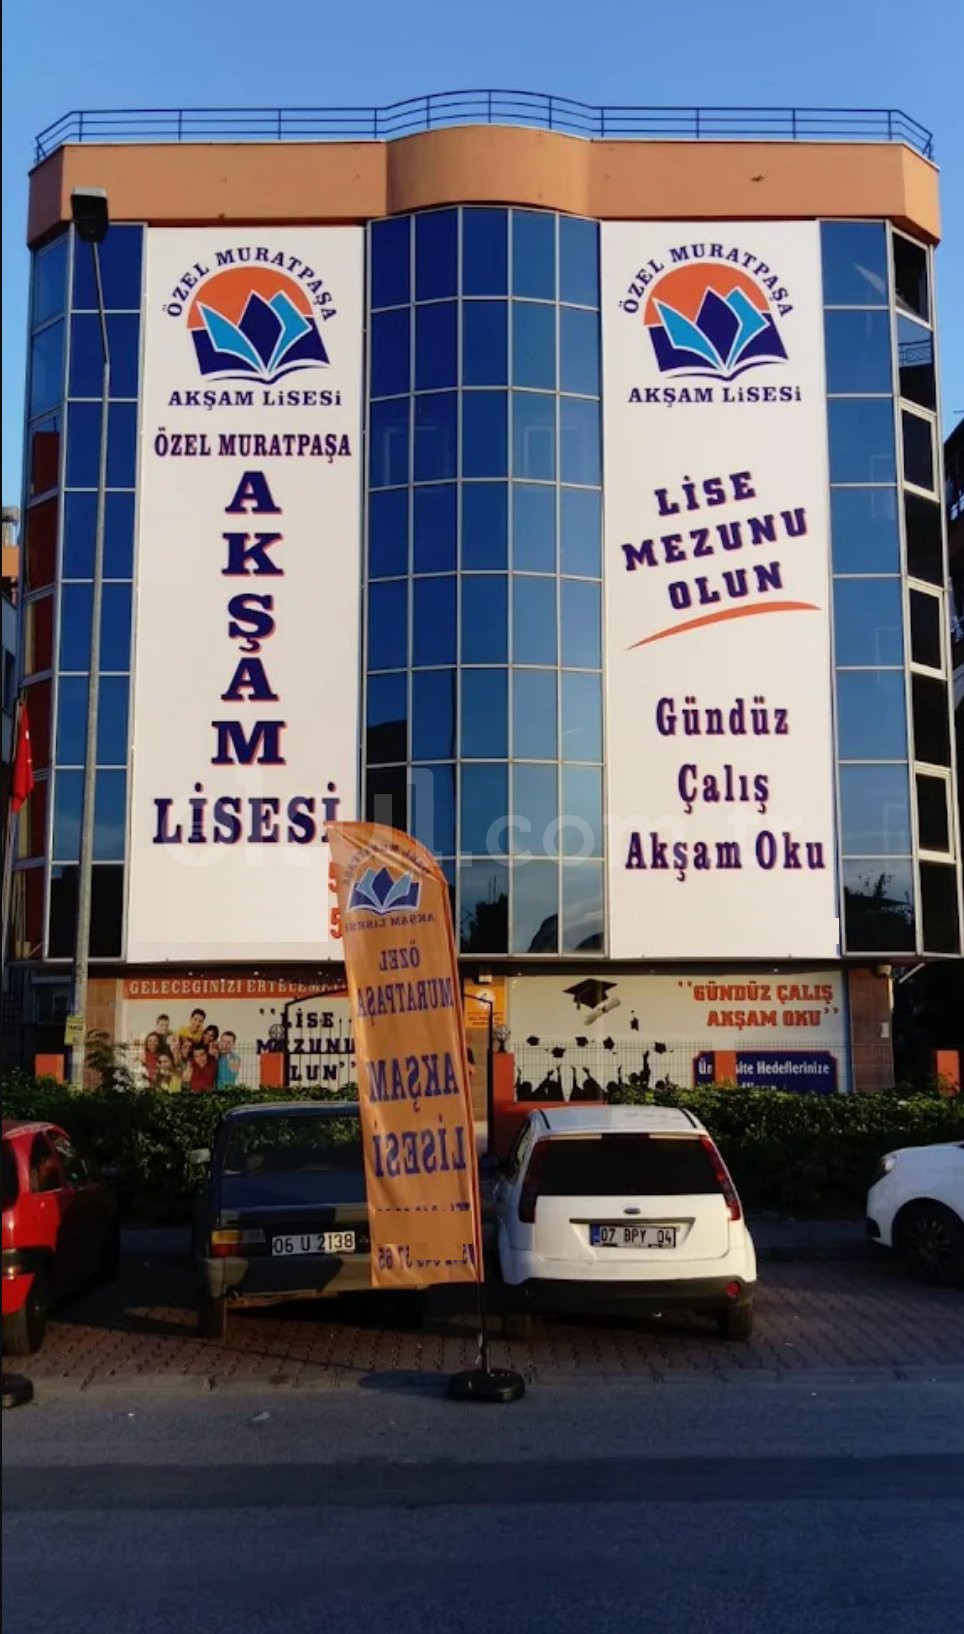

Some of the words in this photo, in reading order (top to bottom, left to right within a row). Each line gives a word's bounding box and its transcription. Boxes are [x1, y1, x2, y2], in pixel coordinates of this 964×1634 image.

[162, 263, 210, 318] ÖZEL
[215, 247, 337, 321] MURATPAŞA
[619, 259, 664, 315] ÖZEL
[669, 243, 794, 318] MURATPAŞA
[168, 391, 253, 410] AKŞAM
[628, 387, 714, 407] AKŞAM
[154, 427, 211, 456] ÖZEL
[218, 433, 352, 463] MURATPAŞA
[654, 471, 756, 517] LİSE
[621, 507, 809, 571] MEZUNU
[668, 561, 784, 610] OLUN
[656, 696, 790, 736] Gündüz
[678, 763, 770, 814] Çalış
[153, 781, 342, 845] LİSESİ
[625, 831, 743, 882] Akşam
[755, 829, 826, 870] Oku
[776, 984, 833, 1005] ÇALIŞ
[706, 1010, 778, 1031] AKŞAM
[756, 1060, 830, 1075] Hedeflerinize
[273, 1237, 294, 1254] 06
[300, 1236, 311, 1251] U
[317, 1233, 354, 1251] 2138
[601, 1228, 616, 1242] 07
[624, 1228, 647, 1243] BPY
[656, 1229, 672, 1245] 04
